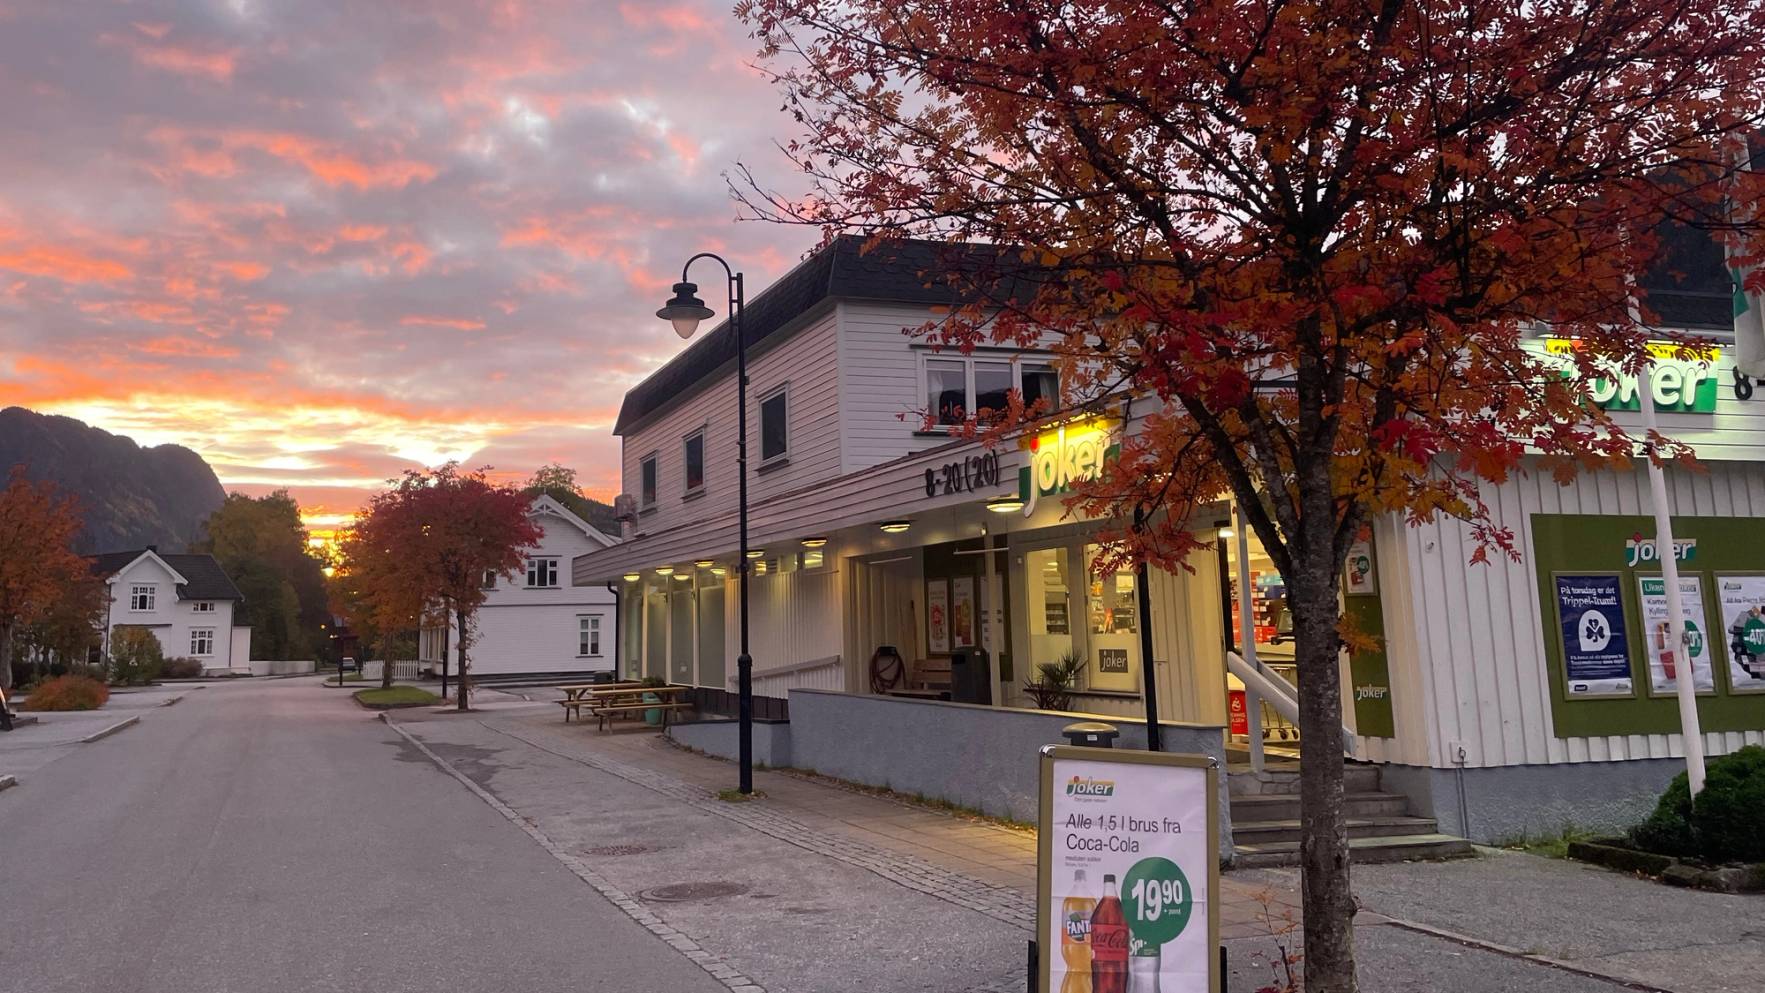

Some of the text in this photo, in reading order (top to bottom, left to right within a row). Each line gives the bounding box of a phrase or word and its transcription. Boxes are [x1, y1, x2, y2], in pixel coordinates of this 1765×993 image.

[1563, 338, 1708, 406] oer
[1024, 425, 1117, 518] joker
[1101, 650, 1128, 672] joker
[1356, 683, 1387, 701] joker
[1066, 776, 1114, 797] joker
[1065, 813, 1092, 830] Alle
[1098, 814, 1117, 832] 1,5
[1129, 816, 1159, 833] brus
[1163, 817, 1181, 834] fra
[1066, 833, 1140, 853] Coca-Cola
[1066, 919, 1092, 936] FANT
